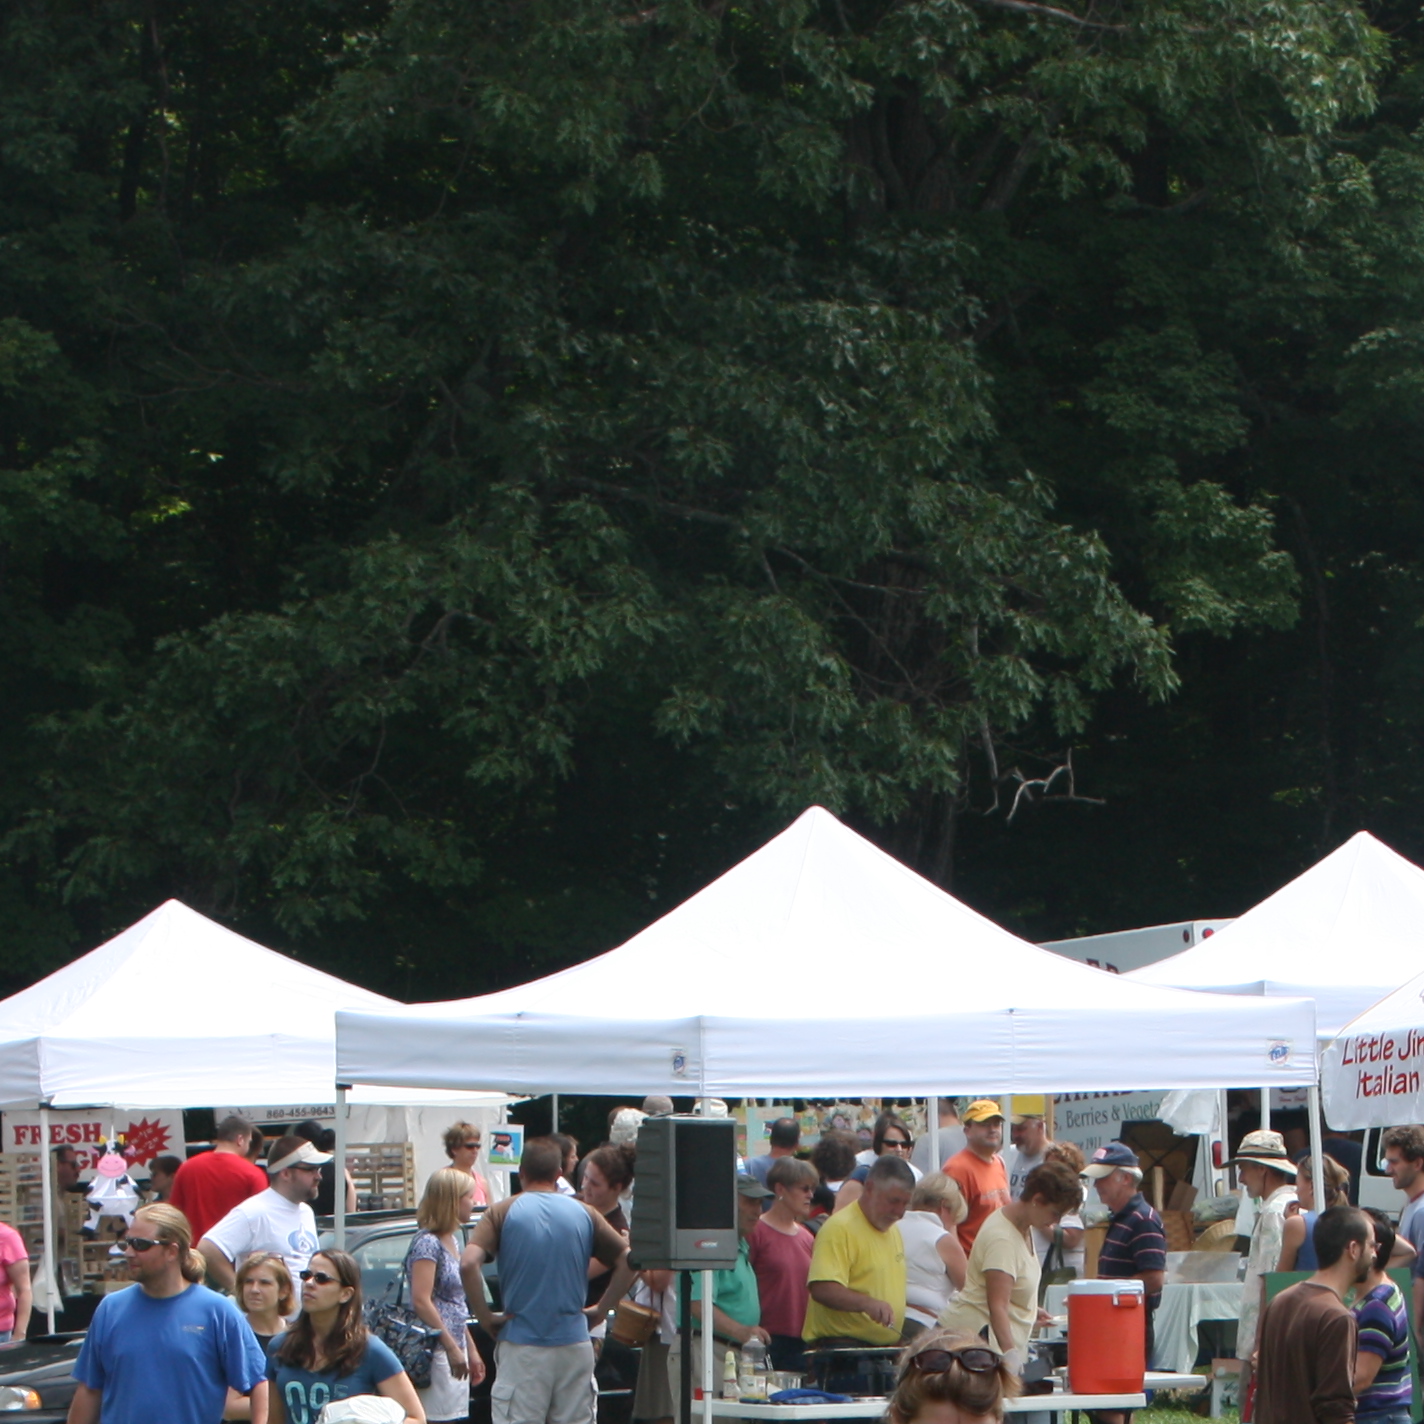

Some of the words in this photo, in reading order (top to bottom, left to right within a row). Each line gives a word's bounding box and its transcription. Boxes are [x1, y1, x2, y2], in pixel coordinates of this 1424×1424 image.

[1341, 1032, 1394, 1066] Little
[1355, 1064, 1420, 1099] Italian
[1066, 1106, 1108, 1128] Berries
[1111, 1104, 1122, 1121] &
[1122, 1099, 1161, 1120] Vegeta
[12, 1122, 102, 1145] FRESH
